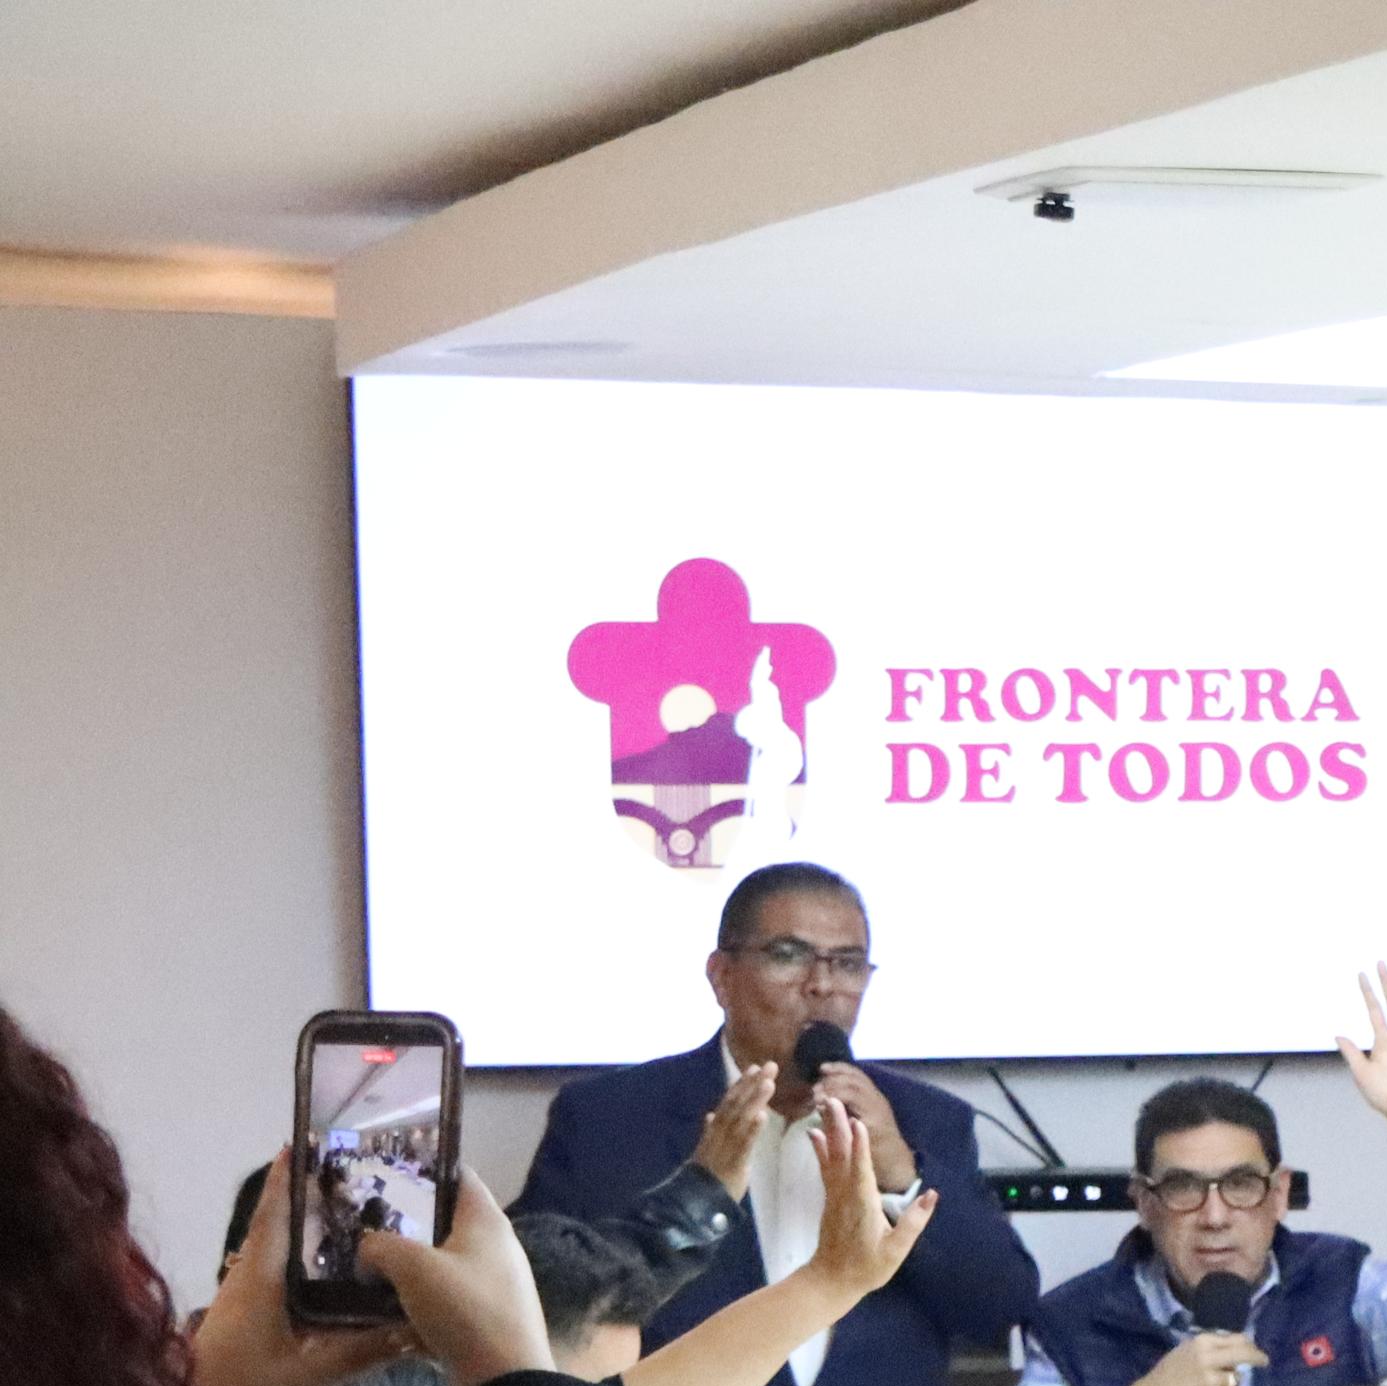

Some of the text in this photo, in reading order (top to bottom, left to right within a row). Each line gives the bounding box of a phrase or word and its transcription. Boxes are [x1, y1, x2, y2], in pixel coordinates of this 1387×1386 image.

[885, 667, 1360, 723] FRONTERA
[885, 741, 1368, 804] DE TODOS
